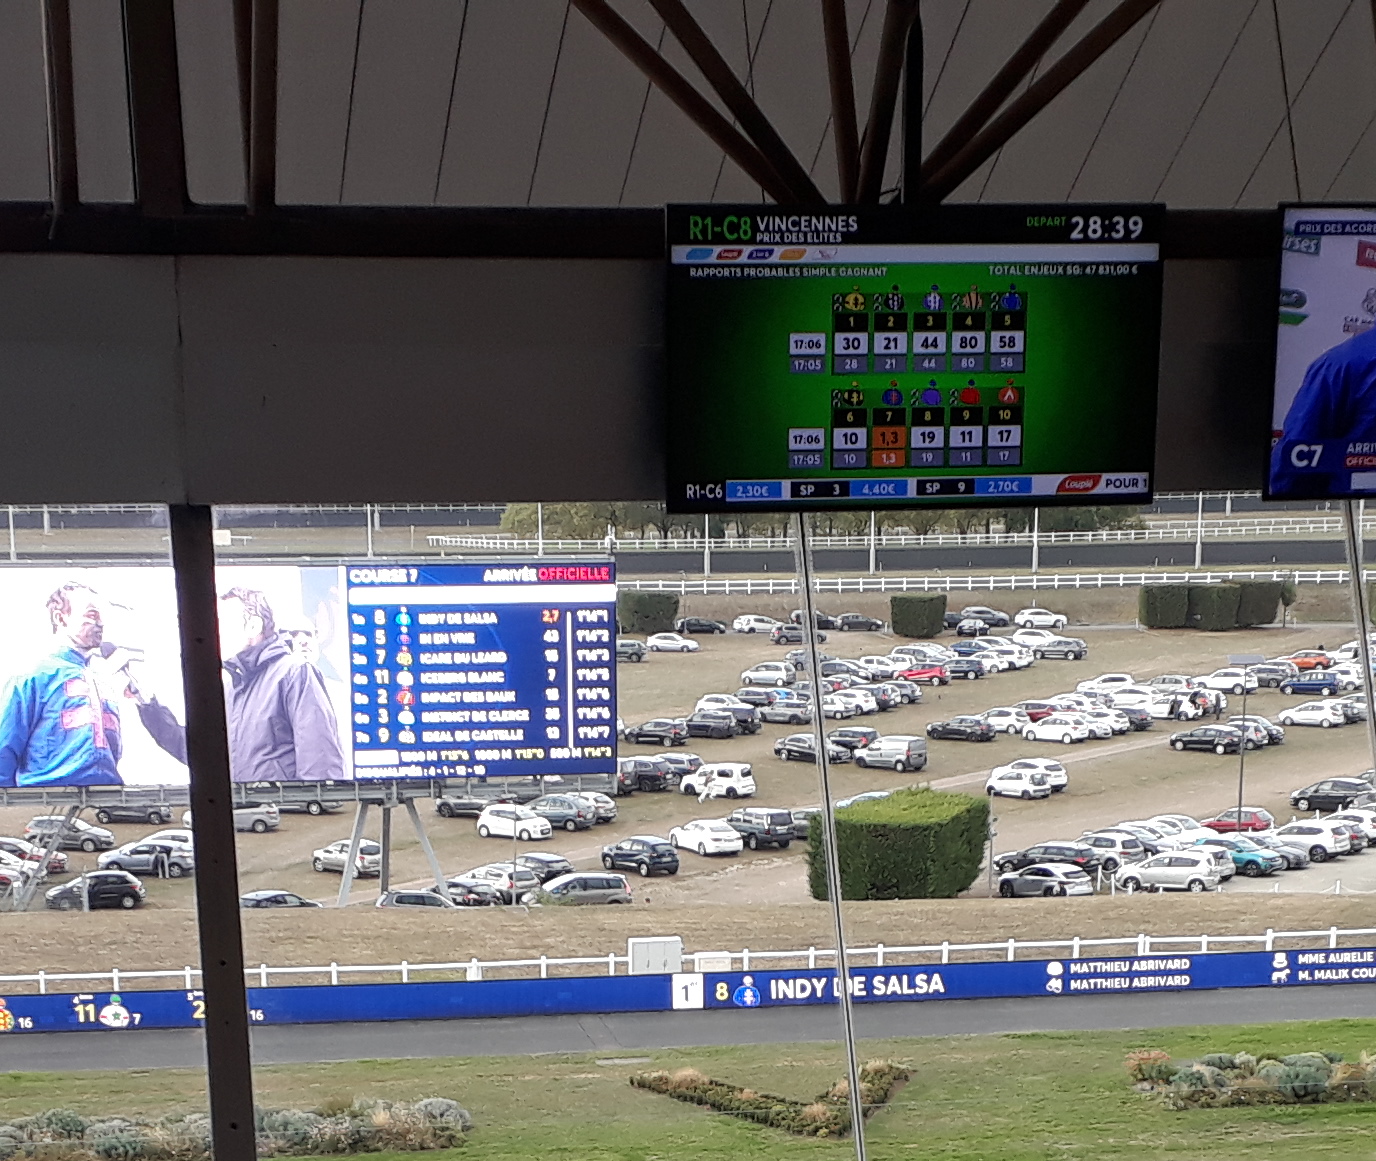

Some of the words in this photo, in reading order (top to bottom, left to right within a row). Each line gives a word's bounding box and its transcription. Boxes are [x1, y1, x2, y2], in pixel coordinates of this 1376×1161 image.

[690, 216, 751, 240] R1-C8
[756, 216, 858, 232] VINCENNES
[1070, 216, 1143, 239] 28:39
[1300, 225, 1321, 233] PRIX
[1324, 224, 1342, 233] DES
[756, 233, 780, 242] PRIX
[784, 233, 804, 242] DES
[808, 233, 842, 242] ELITES
[690, 268, 741, 277] RAPPORTS
[744, 268, 800, 277] PROBABLES
[803, 268, 836, 277] SIMPLE
[840, 268, 887, 276] GAGNANT
[990, 266, 1021, 275] TOTAL
[1025, 266, 1063, 275] ENJEUX
[1085, 266, 1095, 274] 47
[849, 317, 854, 326] 1
[888, 317, 894, 326] 2
[927, 316, 933, 326] 3
[965, 316, 972, 326] 4
[1005, 316, 1010, 325] 5
[794, 340, 821, 349] 17:06
[843, 338, 860, 350] 30
[884, 337, 898, 350] 21
[921, 337, 938, 349] 44
[960, 337, 977, 348] 80
[999, 336, 1015, 348] 58
[794, 361, 821, 370] 17:05
[845, 360, 857, 369] 28
[885, 360, 896, 369] 21
[923, 359, 935, 368] 44
[961, 359, 975, 367] 80
[1001, 358, 1013, 367] 58
[847, 412, 853, 422] 6
[886, 412, 892, 422] 7
[925, 411, 931, 421] 8
[963, 411, 969, 420] 9
[999, 410, 1010, 419] 10
[793, 435, 820, 444] 17:06
[843, 433, 858, 445] 10
[880, 432, 898, 446] 1,3
[921, 432, 935, 444] 19
[960, 431, 973, 443] 11
[998, 430, 1011, 442] 17
[793, 455, 820, 465] 17:05
[844, 454, 856, 463] 10
[922, 453, 932, 462] 19
[961, 452, 971, 461] 11
[999, 452, 1009, 461] 17
[1291, 445, 1322, 467] C7
[687, 484, 722, 498] R1-C6
[736, 486, 768, 497] 2,30€
[800, 486, 814, 495] SP
[833, 485, 840, 494] 3
[863, 484, 895, 495] 4,40€
[926, 483, 940, 493] SP
[958, 482, 965, 492] 9
[988, 482, 1019, 492] 2,70€
[1106, 478, 1138, 488] POUR
[350, 569, 407, 582] COURSE
[410, 569, 417, 582] 7
[484, 567, 537, 582] ARRIVÉE
[539, 568, 609, 580] OFFICIELLE
[376, 630, 386, 644] 5
[376, 650, 386, 663] 7
[375, 670, 389, 683] 11
[378, 690, 387, 703] 2
[378, 710, 388, 723] 3
[379, 729, 389, 743] 9
[1298, 953, 1326, 964] MME
[1328, 952, 1374, 963] AURELIE
[1070, 961, 1129, 973] MATTHIEU
[1132, 959, 1190, 971] ABRIVARD
[1299, 971, 1312, 980] M.
[1315, 969, 1349, 979] MALIX
[716, 982, 728, 1000] 8
[771, 978, 827, 999] INDY
[834, 976, 866, 996] DE
[873, 974, 944, 995] SALSA
[1071, 978, 1129, 990] MATTHIEU
[1132, 976, 1190, 987] ABRIVARD
[18, 1017, 33, 1028] 16
[75, 1004, 96, 1023] 11
[133, 1014, 141, 1025] 7
[192, 1000, 205, 1019] 2
[250, 1010, 264, 1021] 16
